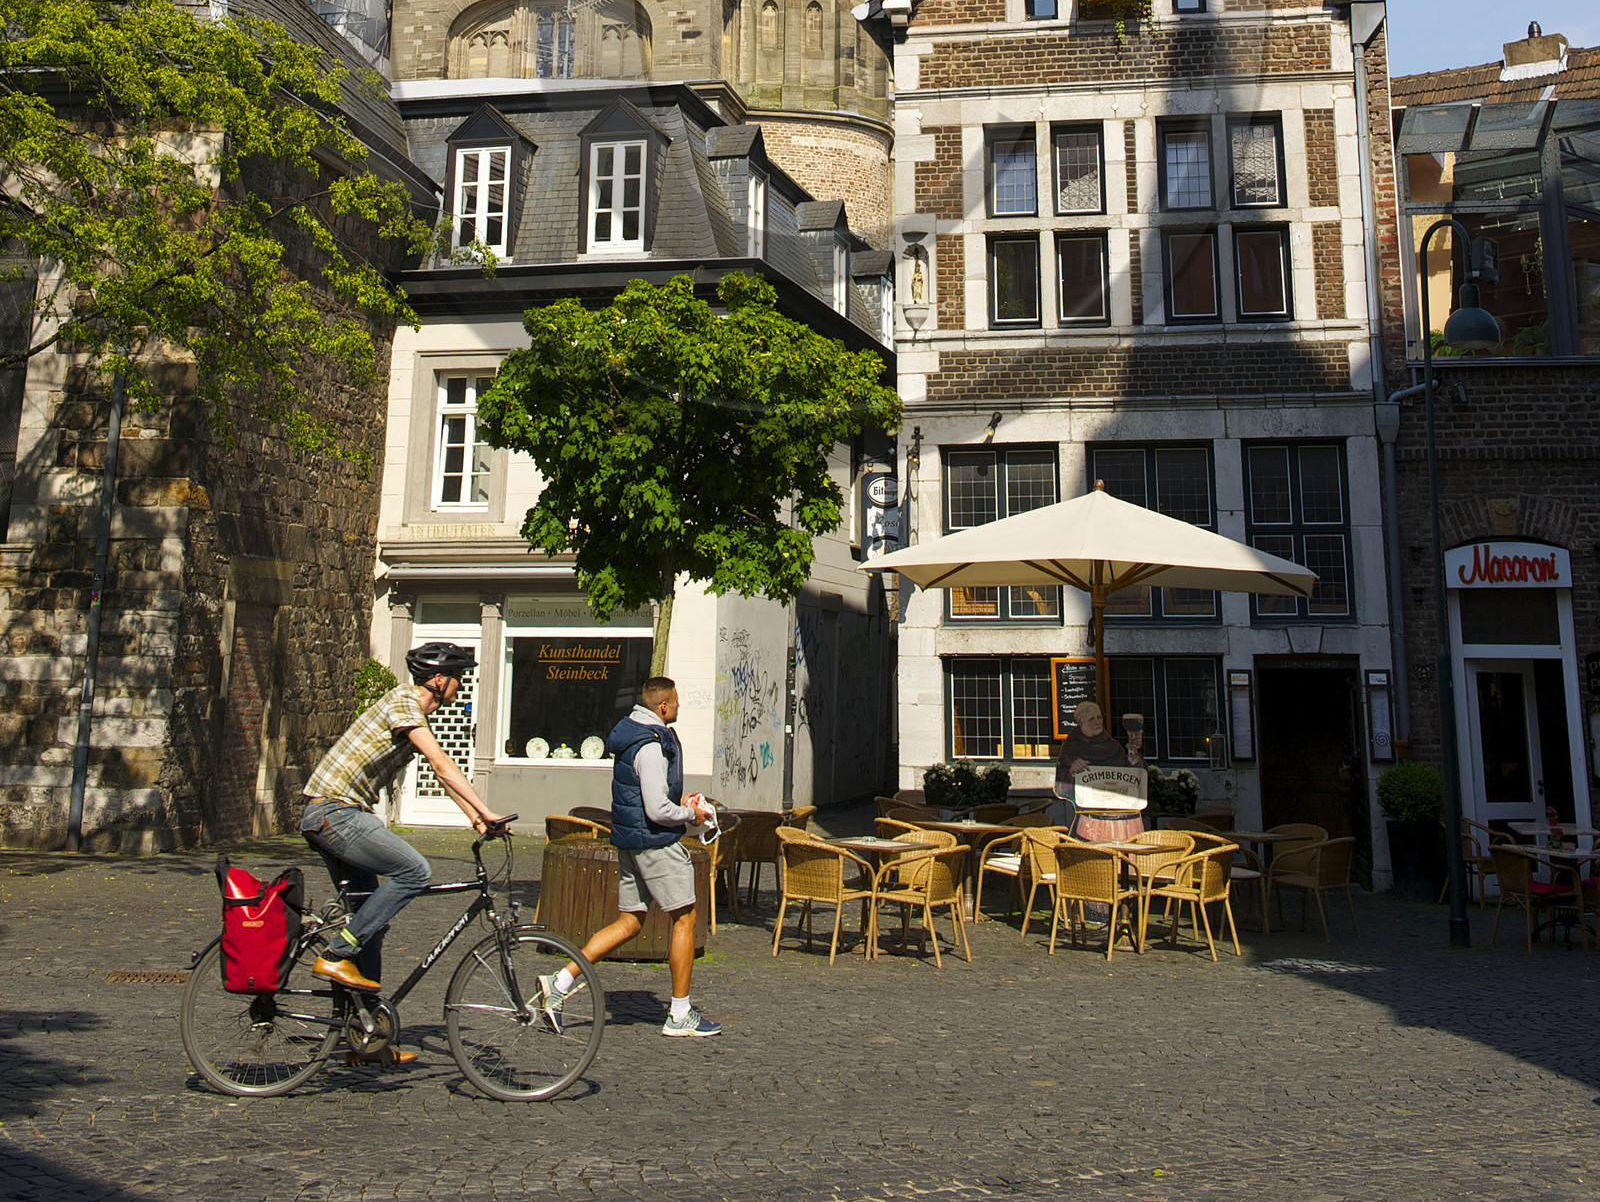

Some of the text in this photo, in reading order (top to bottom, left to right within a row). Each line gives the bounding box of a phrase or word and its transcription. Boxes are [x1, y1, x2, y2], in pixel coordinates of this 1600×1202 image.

[1458, 544, 1559, 584] Macaroni
[508, 608, 545, 618] Porzellan
[554, 607, 580, 617] Möbel
[538, 644, 621, 658] Kunsthandel
[546, 665, 608, 680] Steinbeck
[1082, 771, 1141, 787] GRIMBERGEN
